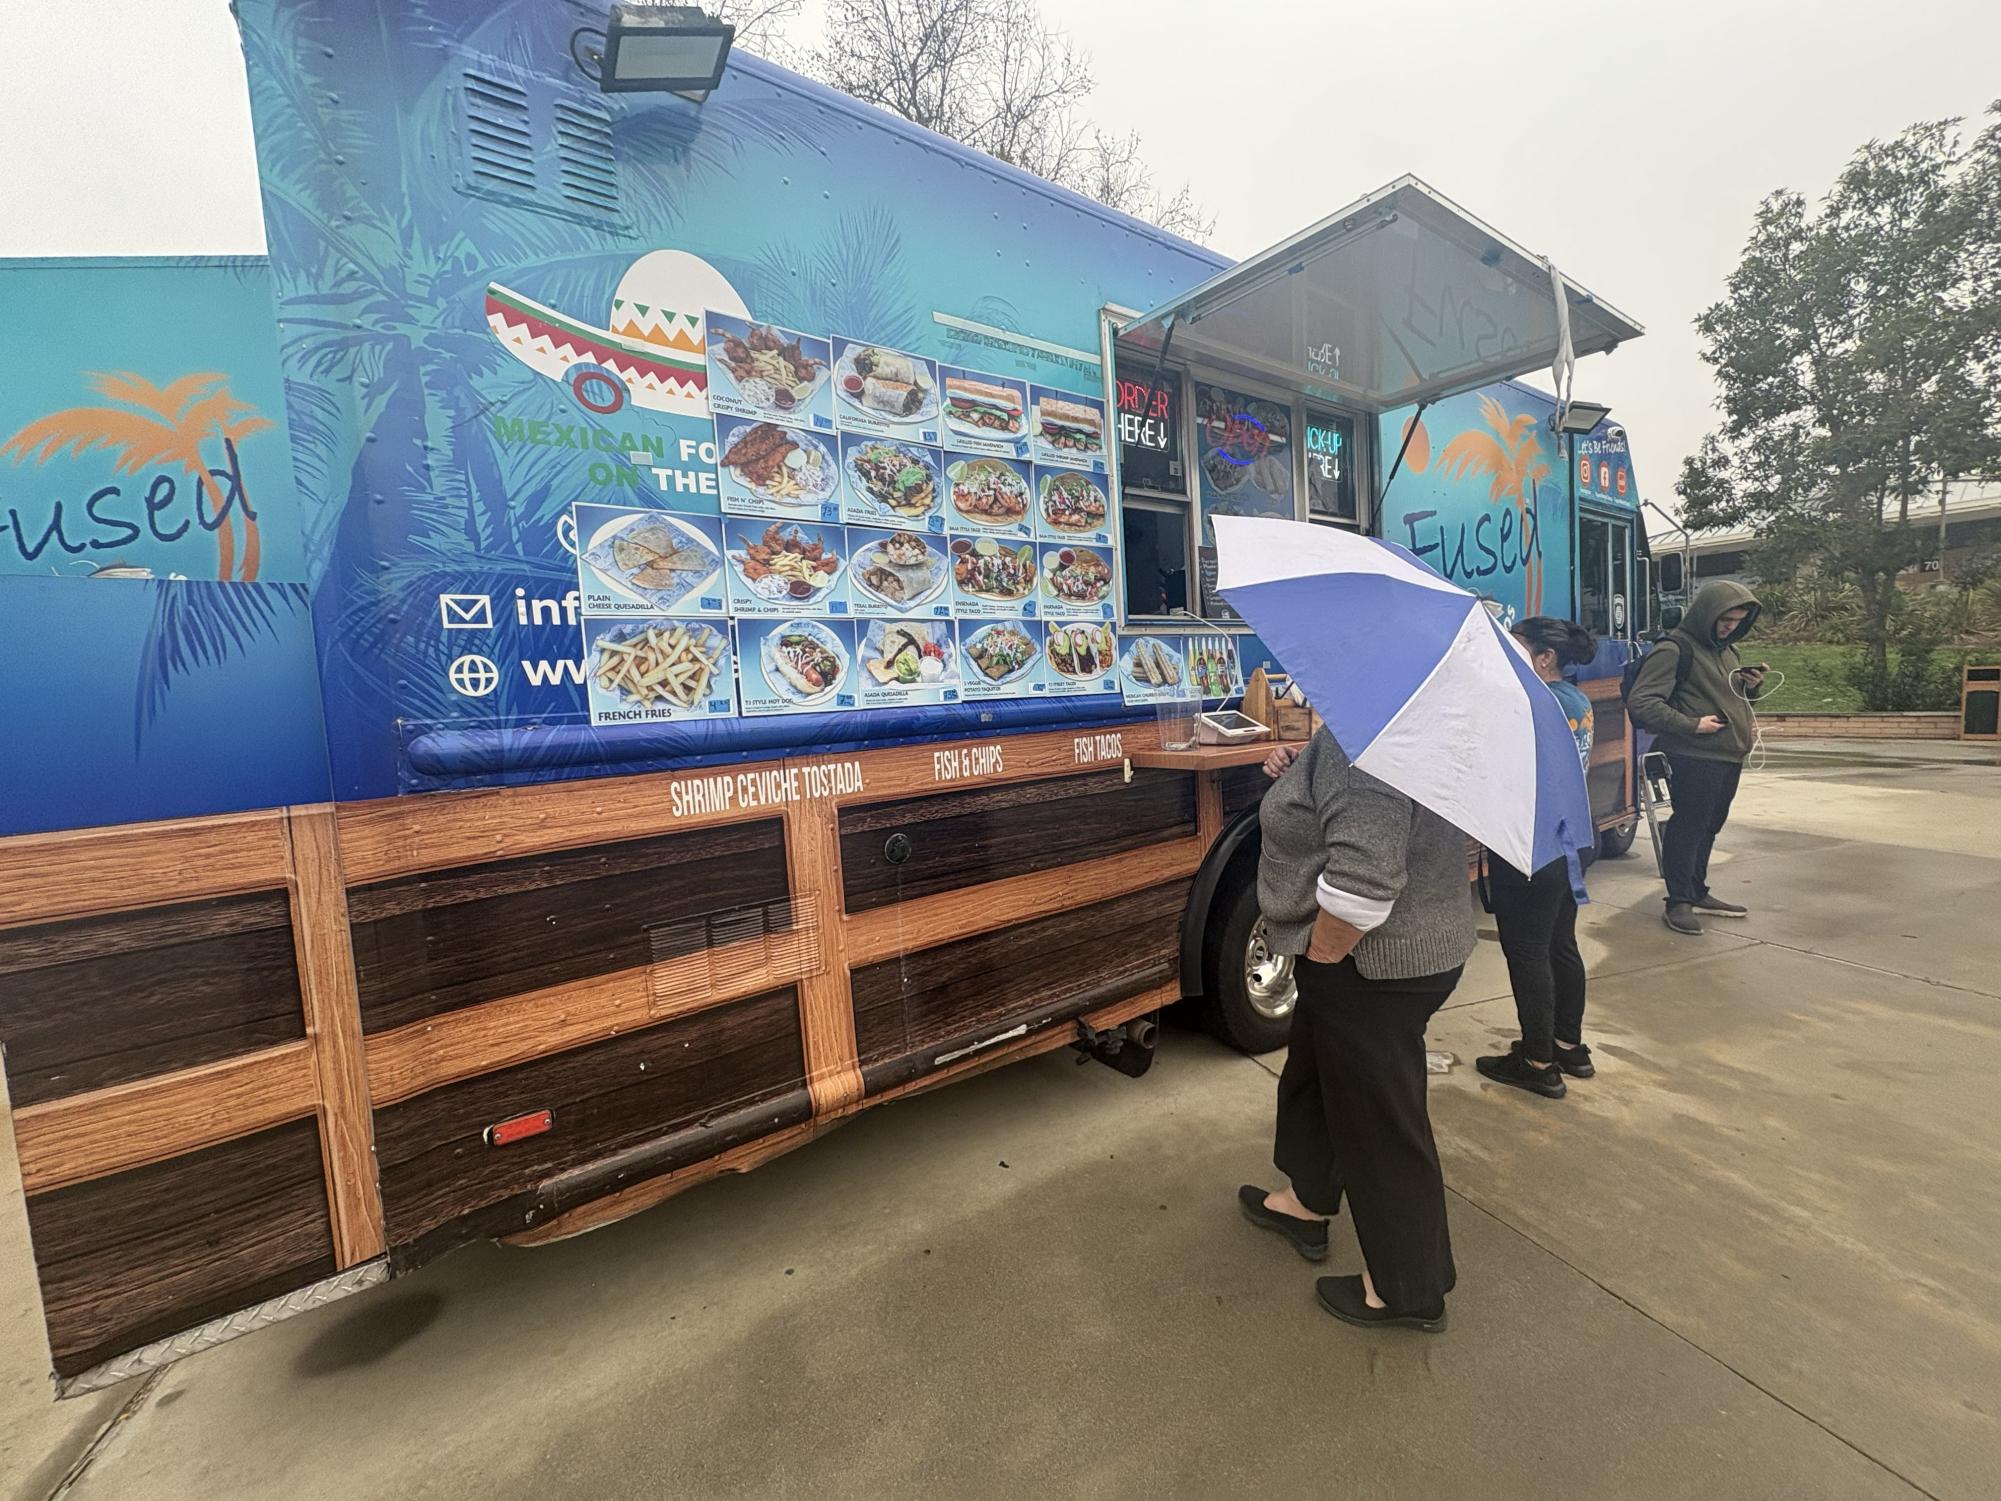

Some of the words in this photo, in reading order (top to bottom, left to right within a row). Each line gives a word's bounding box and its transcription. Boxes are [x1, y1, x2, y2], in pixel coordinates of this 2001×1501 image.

[493, 415, 665, 458] MEXICAN
[1307, 426, 1342, 455] ICK-UP
[588, 462, 641, 488] ON
[651, 467, 718, 494] THE
[0, 437, 257, 561] used
[1403, 478, 1542, 580] Fused
[1924, 560, 1939, 571] 70
[588, 602, 613, 610] CHEESE
[614, 602, 655, 610] QUESADILLA
[598, 710, 642, 721] FRENCH
[645, 708, 672, 719] FRIES
[933, 751, 960, 781] FISH
[961, 750, 970, 777] &
[972, 745, 1003, 775] CHIPS
[1074, 737, 1093, 764] FISH
[1094, 733, 1122, 761] TACOS
[670, 774, 733, 817] SHRIMP
[737, 767, 800, 808] CEVICHE
[801, 760, 863, 799] TOSTADA
